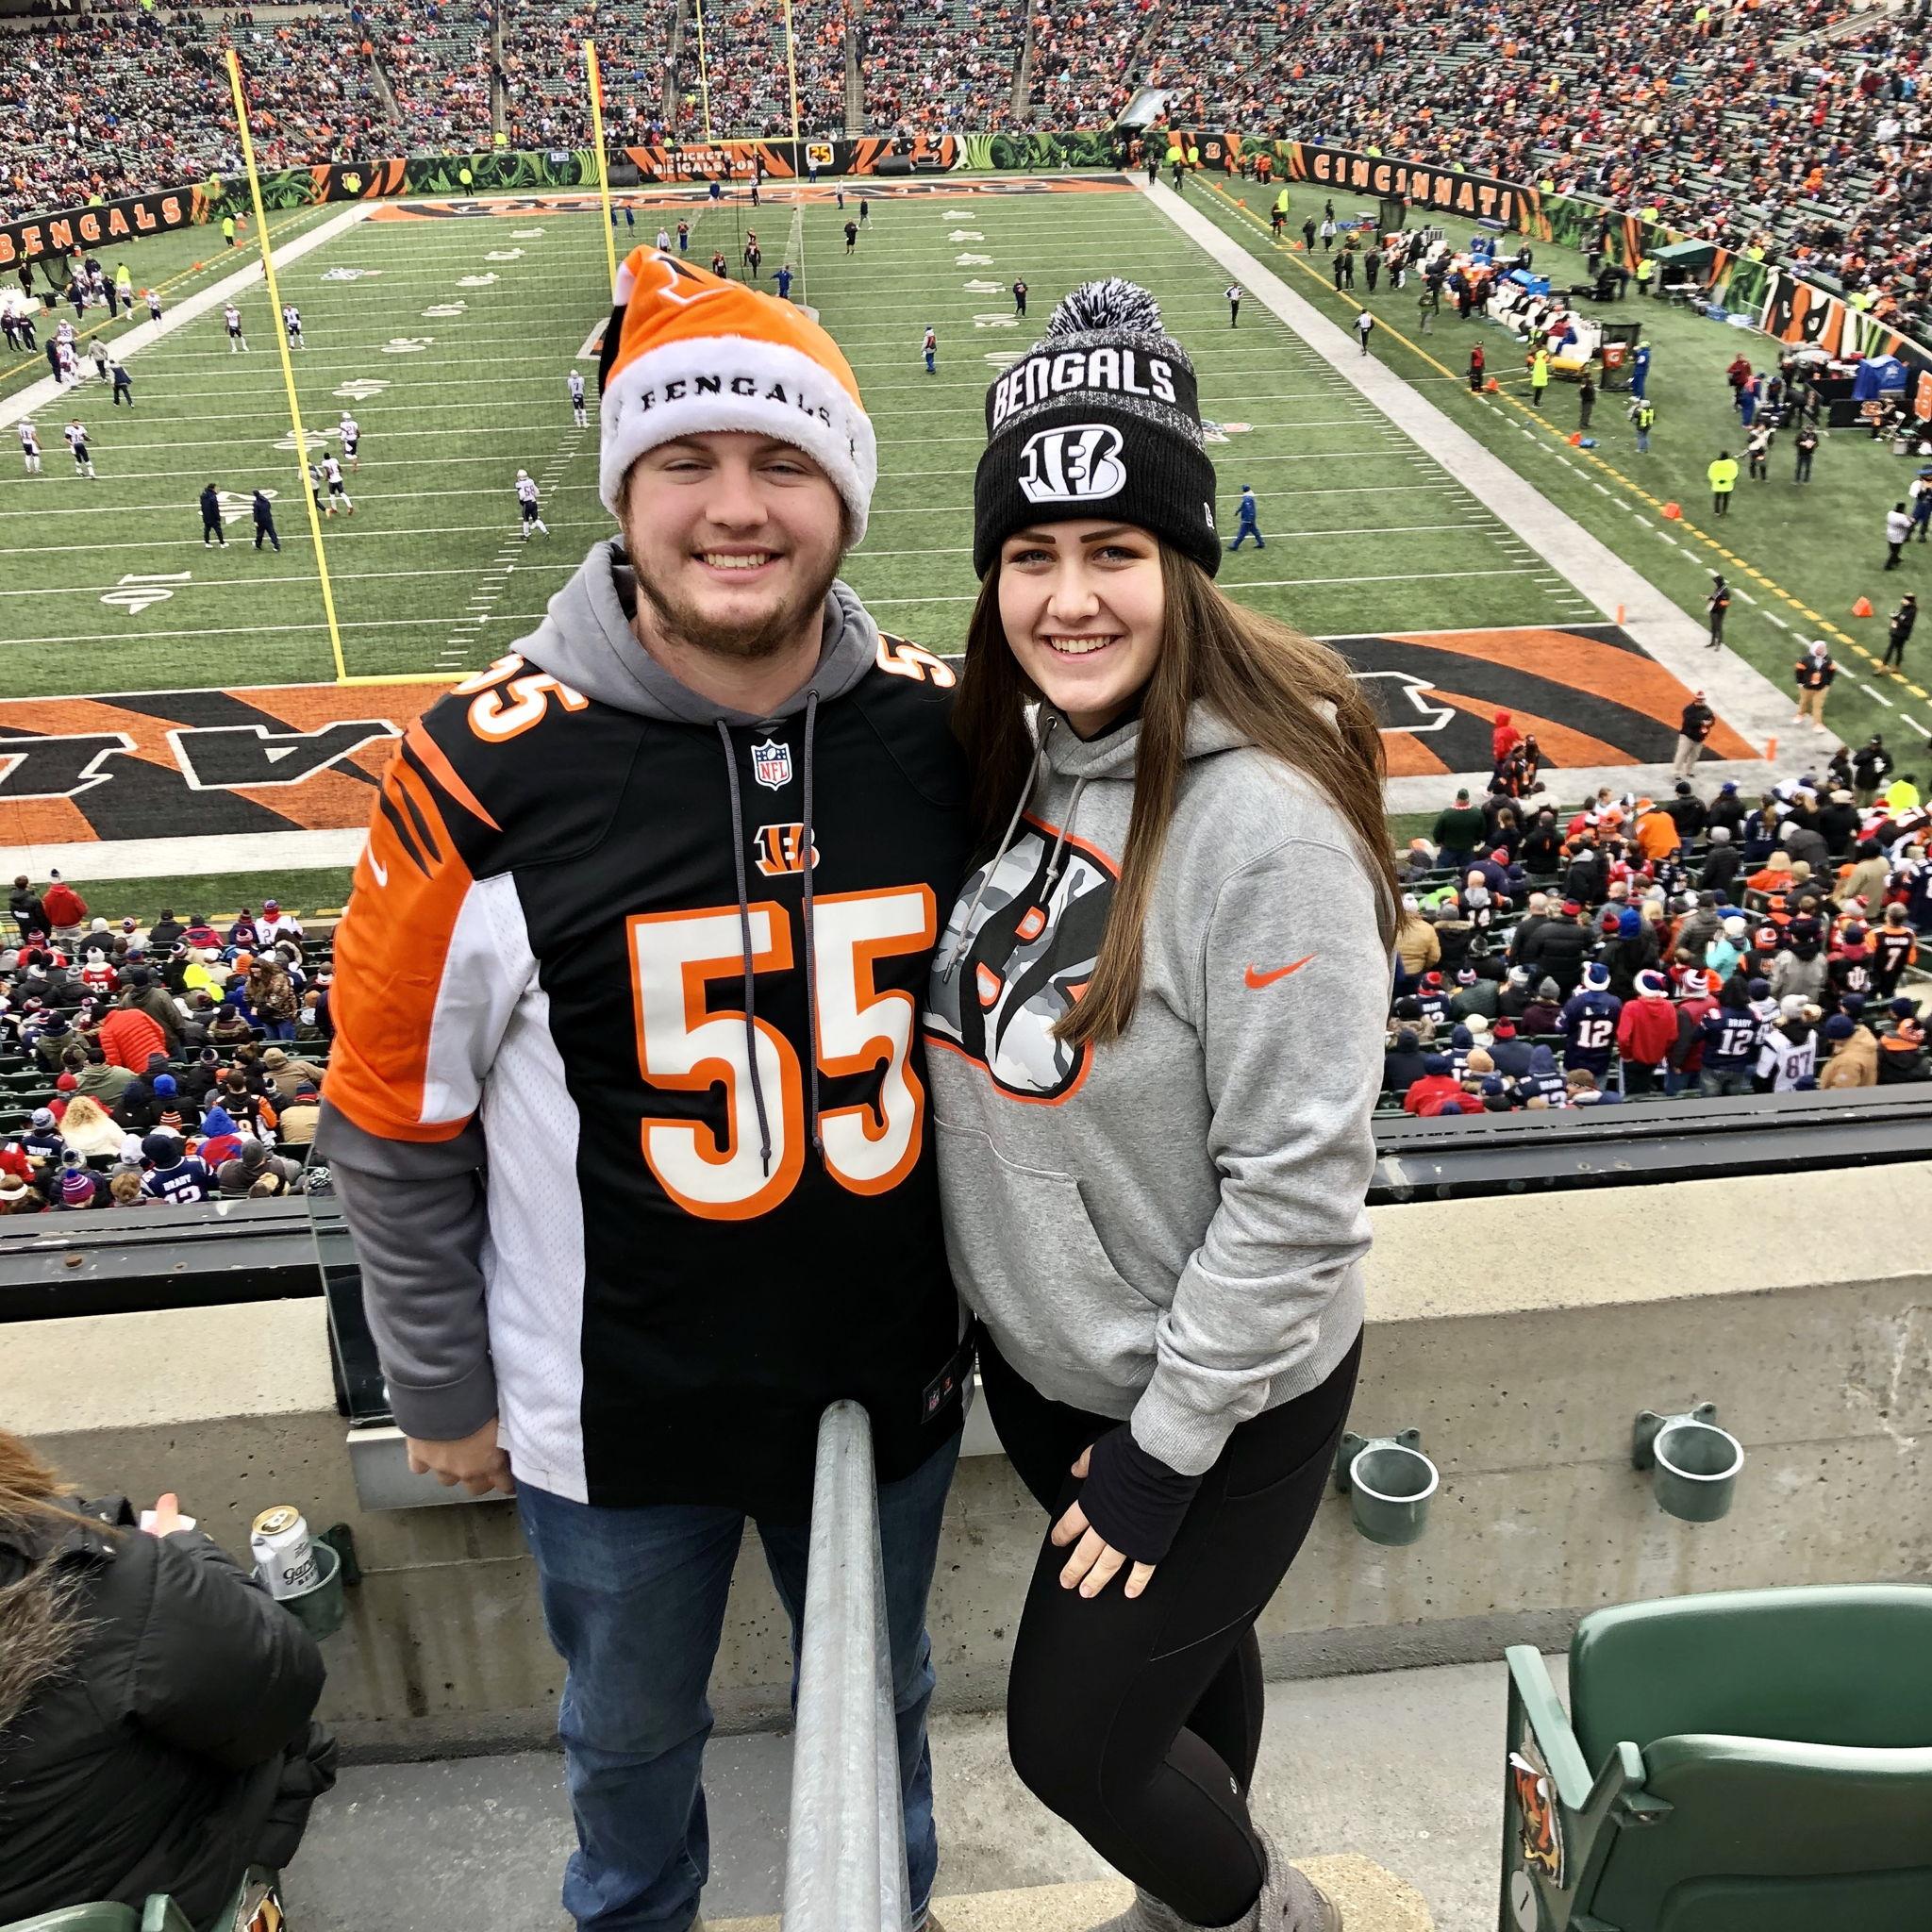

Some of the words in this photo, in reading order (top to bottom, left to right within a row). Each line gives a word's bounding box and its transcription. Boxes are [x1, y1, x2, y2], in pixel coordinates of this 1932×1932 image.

[1313, 154, 1512, 220] CINCINNATI
[0, 196, 181, 263] BENGALS
[993, 347, 1176, 429] BENGALS
[759, 761, 788, 781] NFL
[1885, 947, 1902, 971] 7
[1577, 1020, 1613, 1048] 12
[1728, 1018, 1752, 1028] BRADY
[626, 883, 938, 1221] 55
[1717, 1029, 1754, 1056] 12
[1786, 1050, 1812, 1079] 87
[162, 1174, 192, 1191] BRADY
